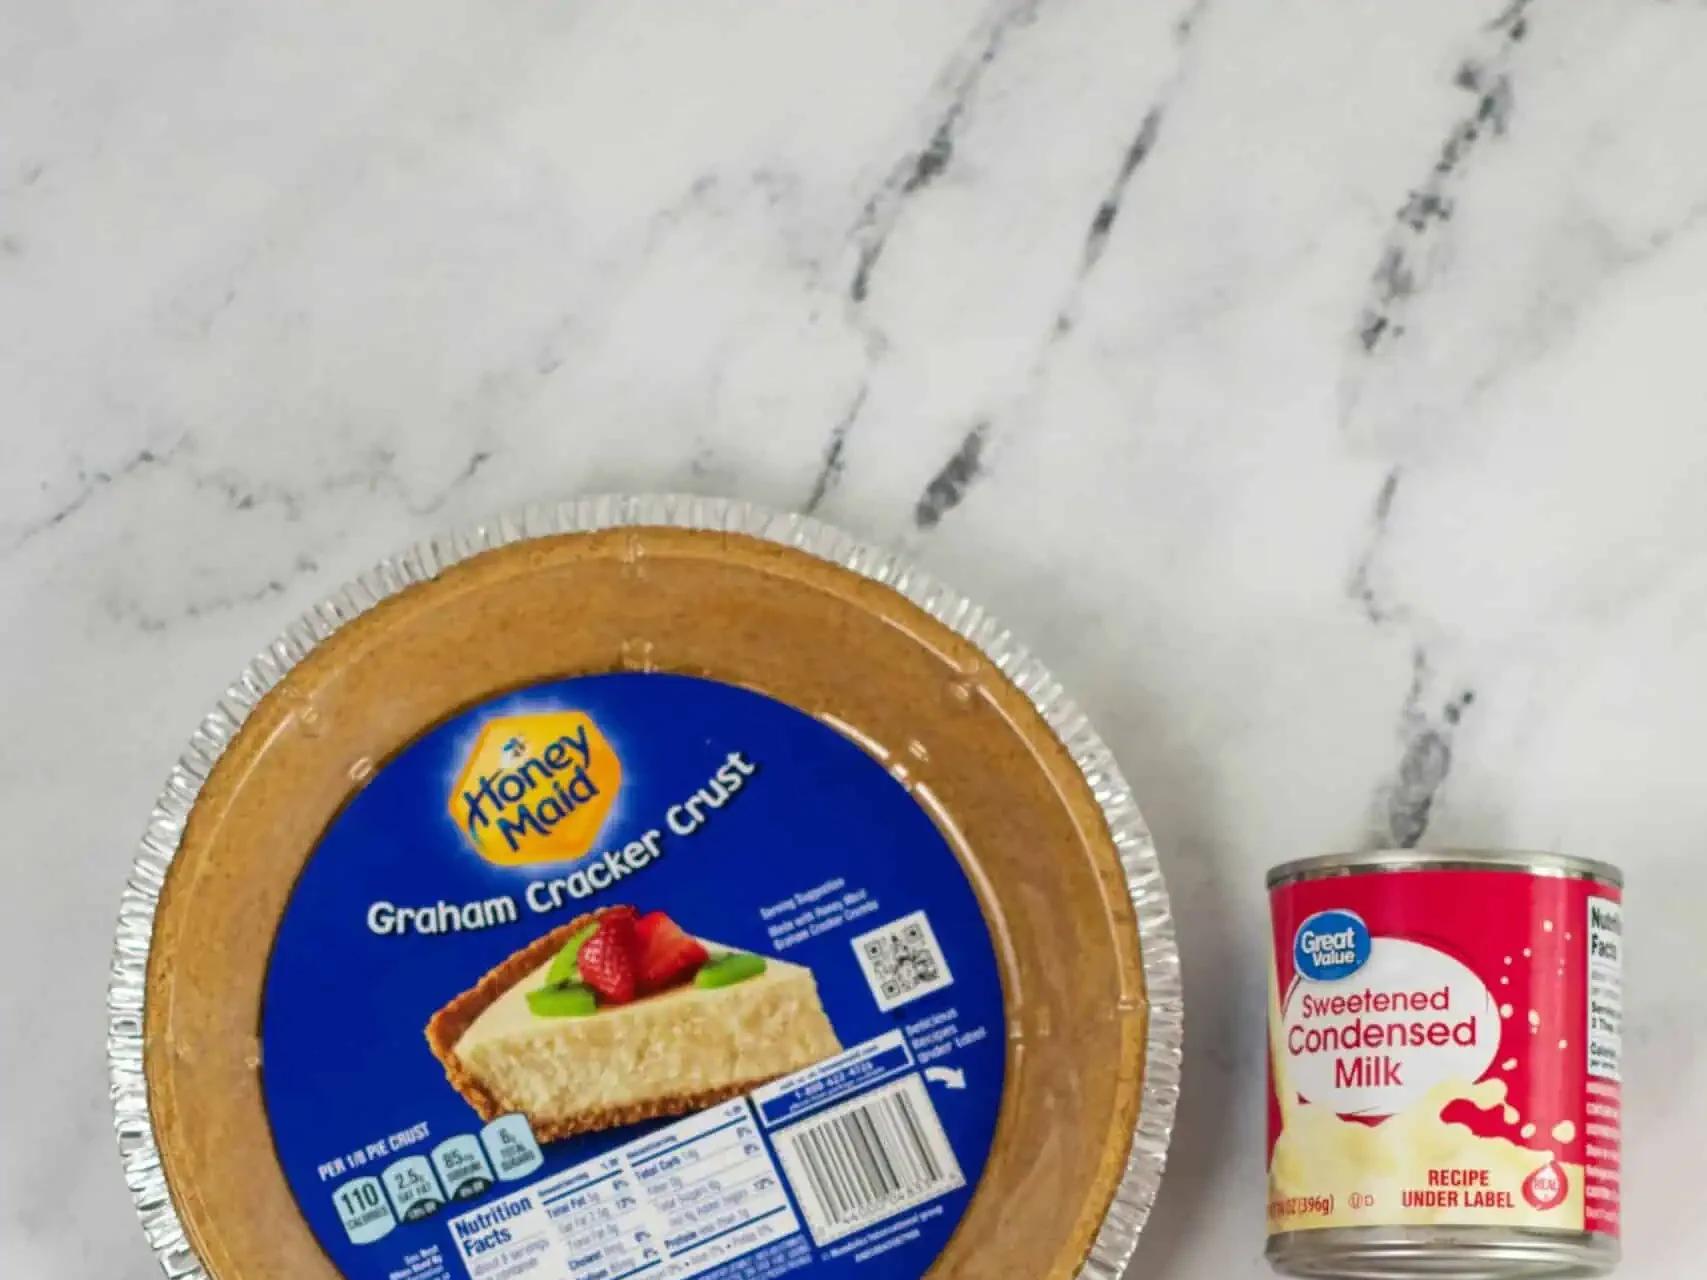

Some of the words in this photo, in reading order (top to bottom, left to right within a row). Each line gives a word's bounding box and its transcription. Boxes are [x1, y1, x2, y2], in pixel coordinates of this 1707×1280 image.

[462, 724, 592, 842] Honey
[496, 765, 600, 853] Maid
[366, 895, 517, 936] Graham
[525, 829, 662, 914] Cracker
[665, 750, 756, 836] Crust
[1301, 926, 1356, 954] Great
[1312, 950, 1356, 967] Value
[1302, 986, 1450, 1019] Sweetened
[1288, 1015, 1477, 1056] Condensed
[1334, 1055, 1404, 1088] Milk
[317, 1158, 347, 1180] PER
[366, 1140, 389, 1159] PIE
[388, 1121, 430, 1148] CRUST
[1428, 1169, 1489, 1187] RECIPE
[341, 1185, 379, 1214] 110
[1402, 1191, 1458, 1208] UNDER
[1464, 1191, 1515, 1208] LABEL
[456, 1196, 530, 1237] Nutrition
[464, 1227, 512, 1256] Facts
